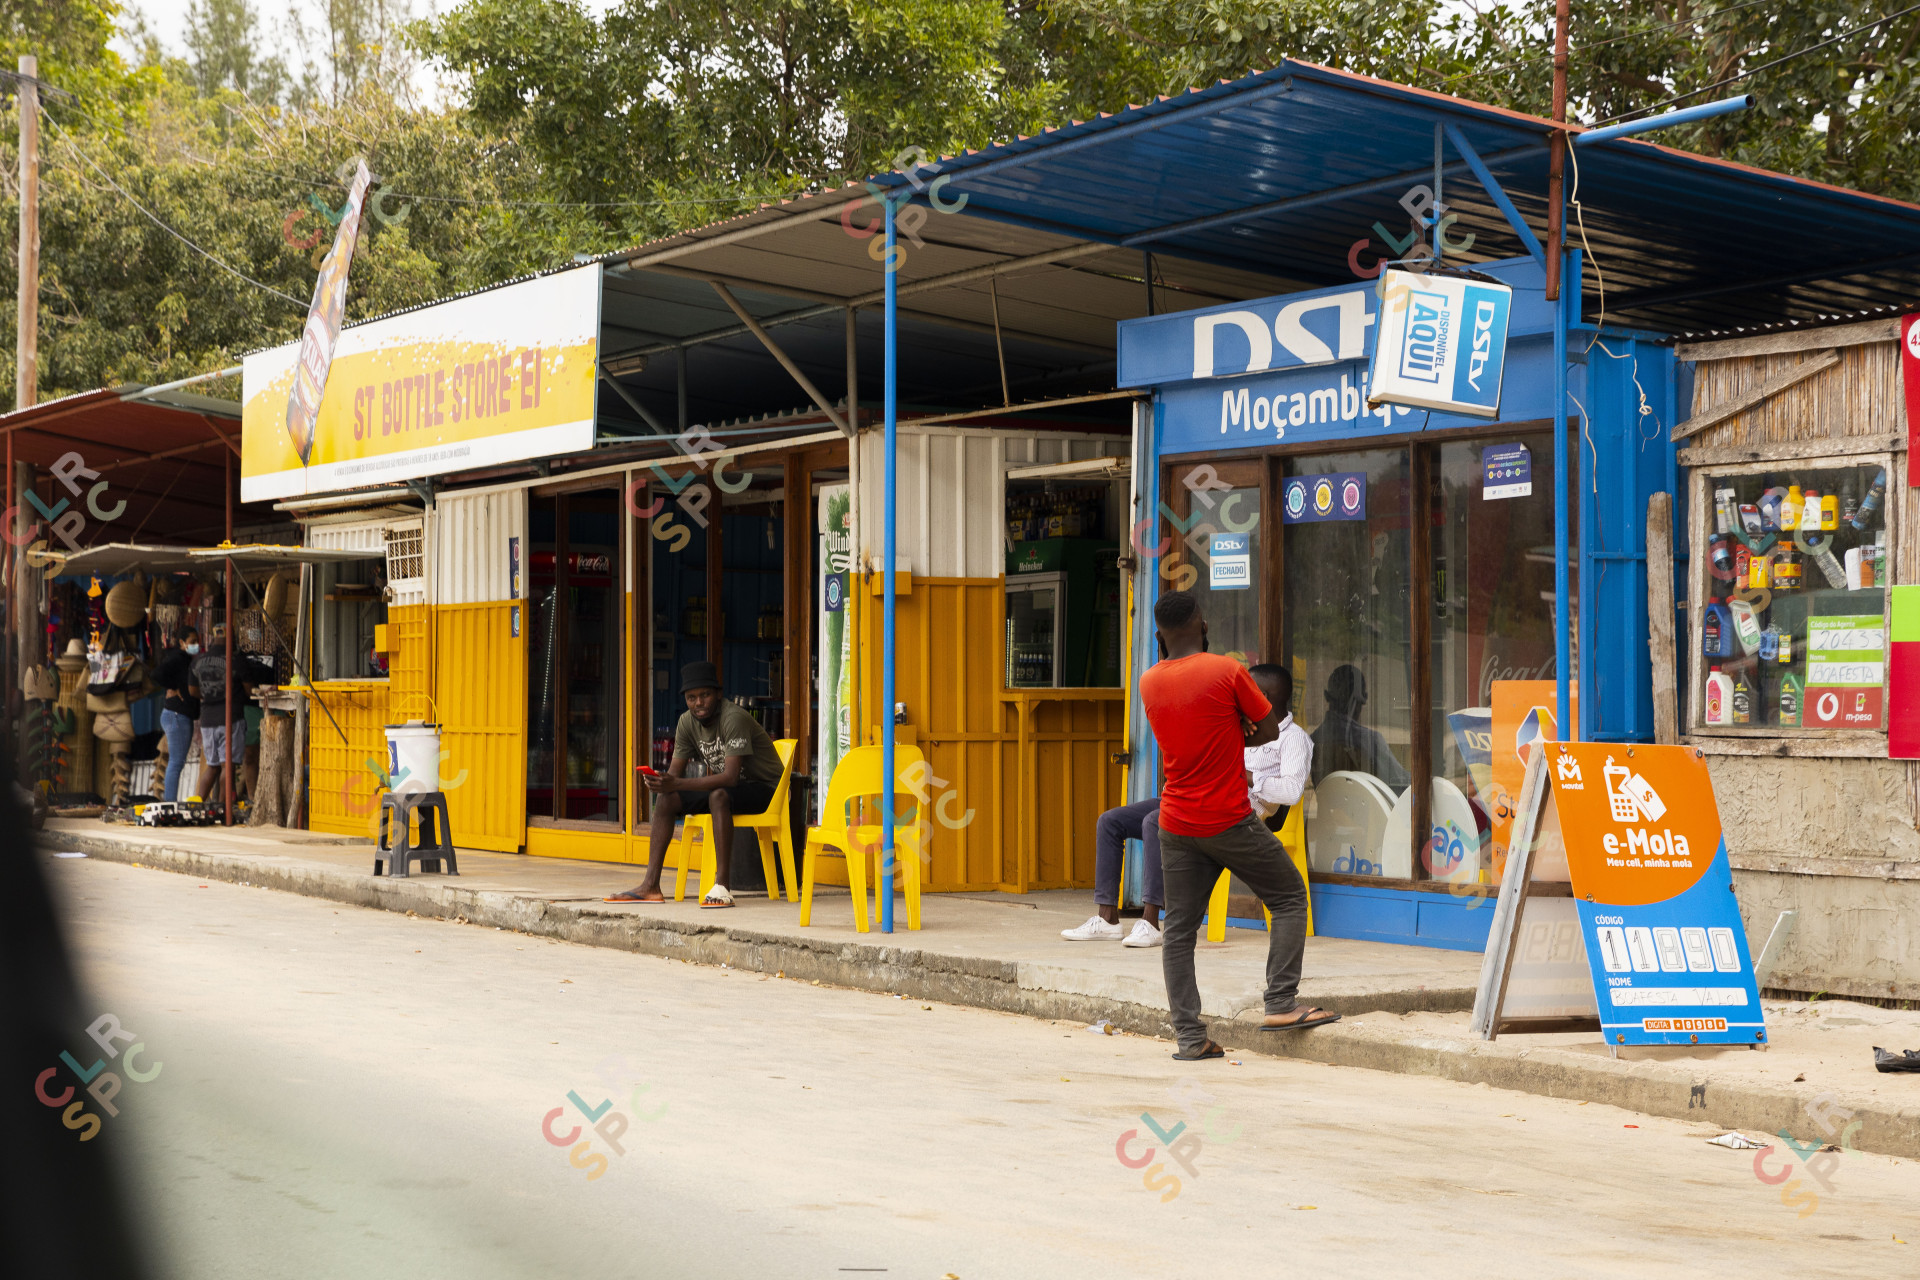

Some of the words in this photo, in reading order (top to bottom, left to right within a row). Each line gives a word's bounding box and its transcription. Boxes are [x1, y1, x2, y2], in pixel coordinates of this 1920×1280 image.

[1408, 302, 1439, 373] AQUI
[1434, 310, 1450, 368] DISPONÍVEL
[1468, 300, 1495, 393] DStv
[354, 386, 375, 441] ST
[382, 370, 444, 436] BOTTLE
[452, 354, 511, 423] STORE
[1215, 540, 1244, 550] DStv
[1215, 566, 1244, 576] FECHADO
[1846, 713, 1873, 722] m-pesa
[1603, 828, 1690, 856] e-Mola
[1606, 857, 1625, 867] Meu
[1645, 858, 1670, 868] minha
[1672, 859, 1692, 868] mola
[1595, 914, 1624, 925] CÓDIGO
[1608, 977, 1632, 986] NOME
